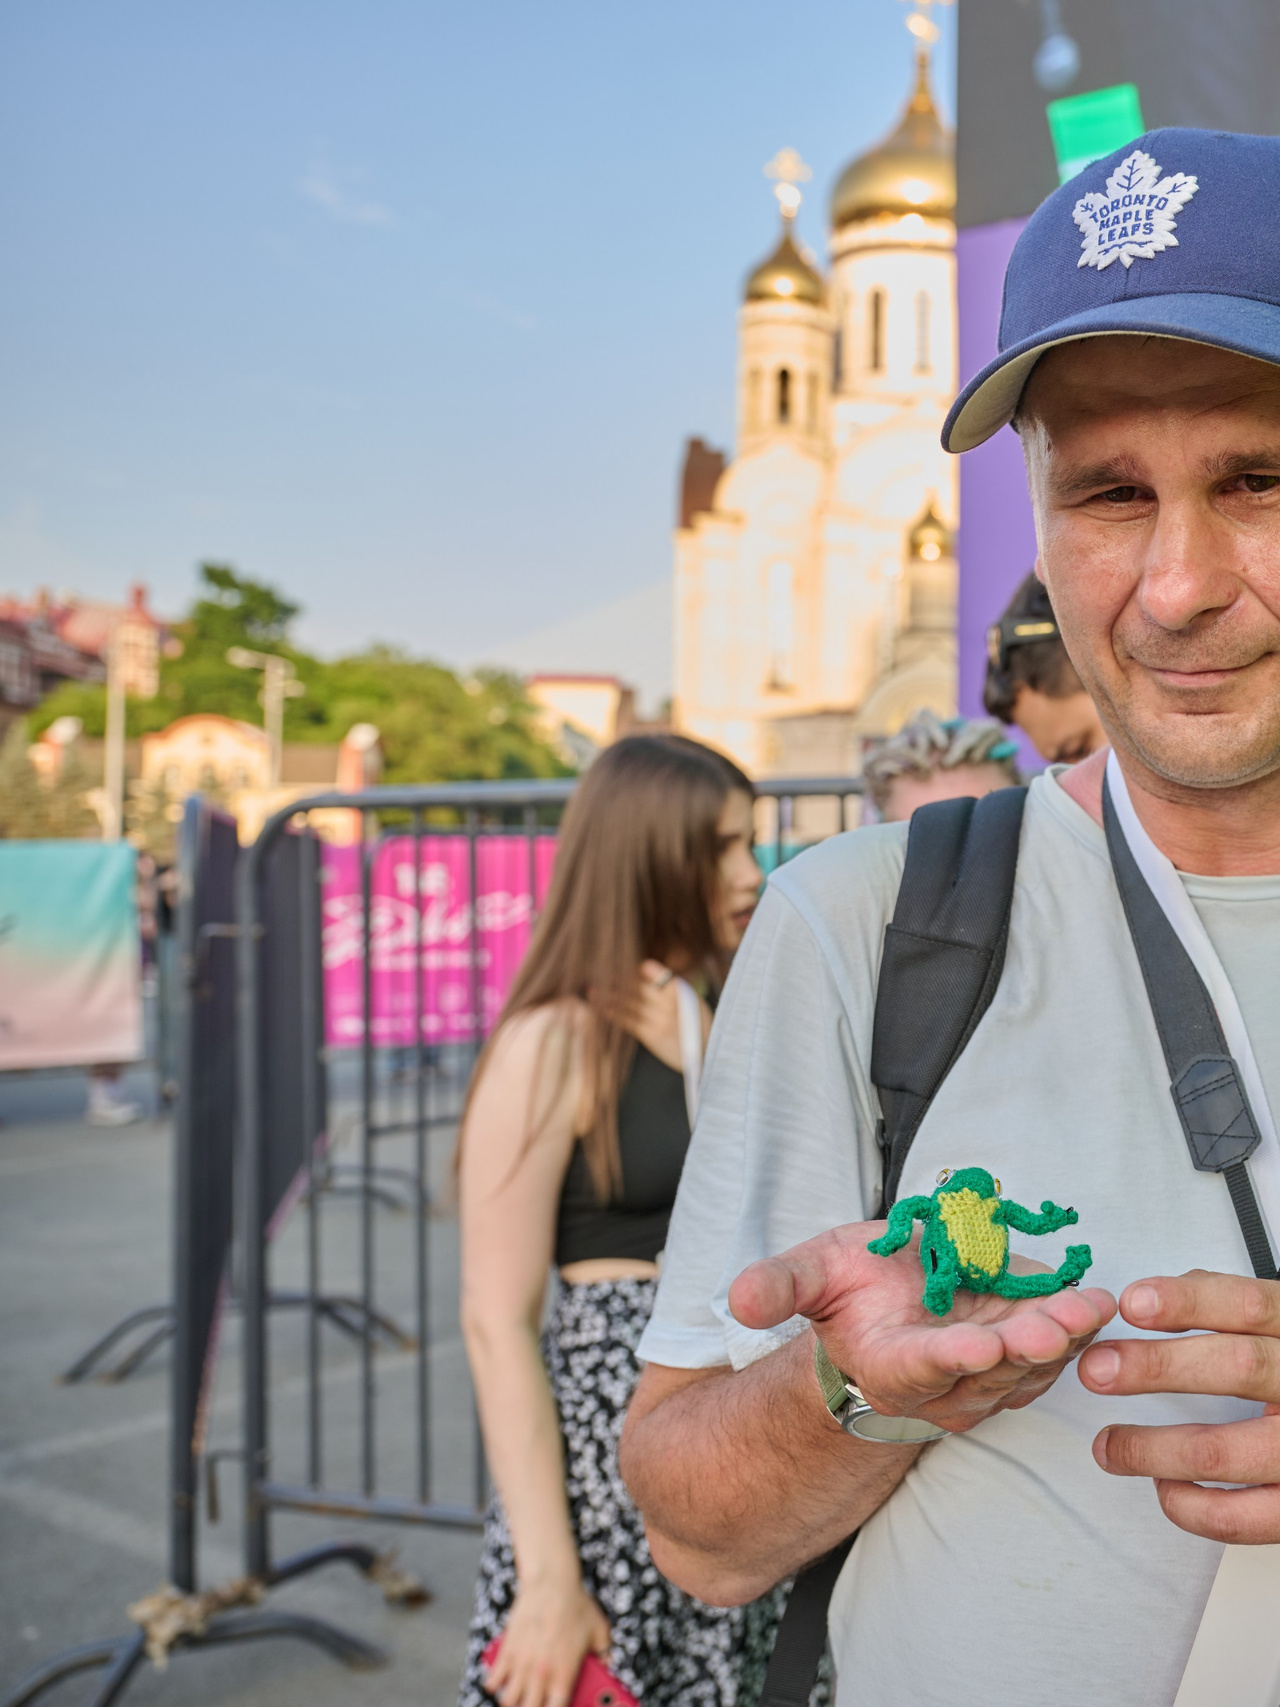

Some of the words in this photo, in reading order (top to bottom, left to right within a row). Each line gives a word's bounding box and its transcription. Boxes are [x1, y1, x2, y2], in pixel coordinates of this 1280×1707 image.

[1089, 194, 1169, 223] TORONTO
[1098, 209, 1154, 231] MAPLE
[1098, 222, 1154, 246] LEAFS
